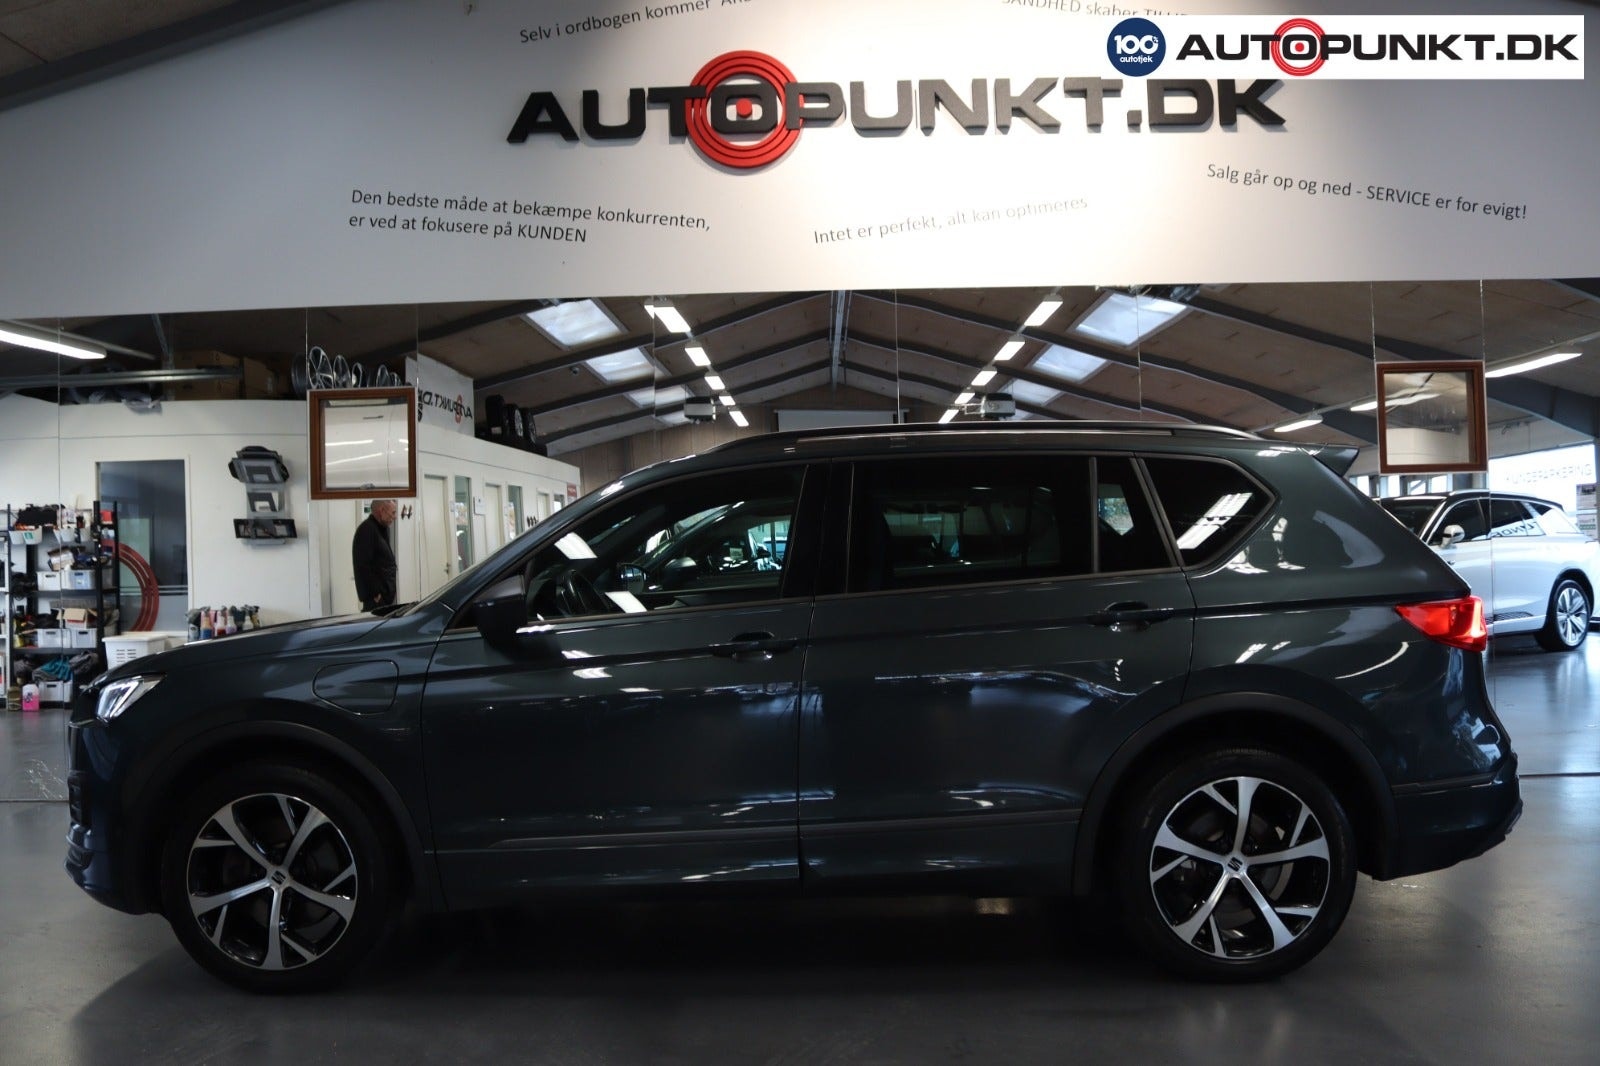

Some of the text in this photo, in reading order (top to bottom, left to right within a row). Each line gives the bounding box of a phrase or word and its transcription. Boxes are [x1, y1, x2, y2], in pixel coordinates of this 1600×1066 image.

[519, 0, 711, 43] Selv i ordbogen kommer
[1003, 0, 1081, 13] NDHED
[507, 77, 1287, 144] AUTOPUNKT.DK
[351, 189, 711, 232] Den bedste måde at bekæmpe konkurrenten,
[1207, 164, 1239, 184] Salg
[1243, 169, 1269, 186] går
[1273, 176, 1293, 190] op
[1298, 179, 1317, 195] og
[1322, 181, 1351, 196] ned
[1366, 185, 1431, 207] SERVICE
[1435, 197, 1451, 209] er
[1456, 196, 1478, 213] for
[1483, 202, 1527, 221] evigt!
[349, 214, 587, 243] er ved at fokusere på KUNDEN
[814, 196, 1089, 244] Intet er perfekt, alt kan optimeres
